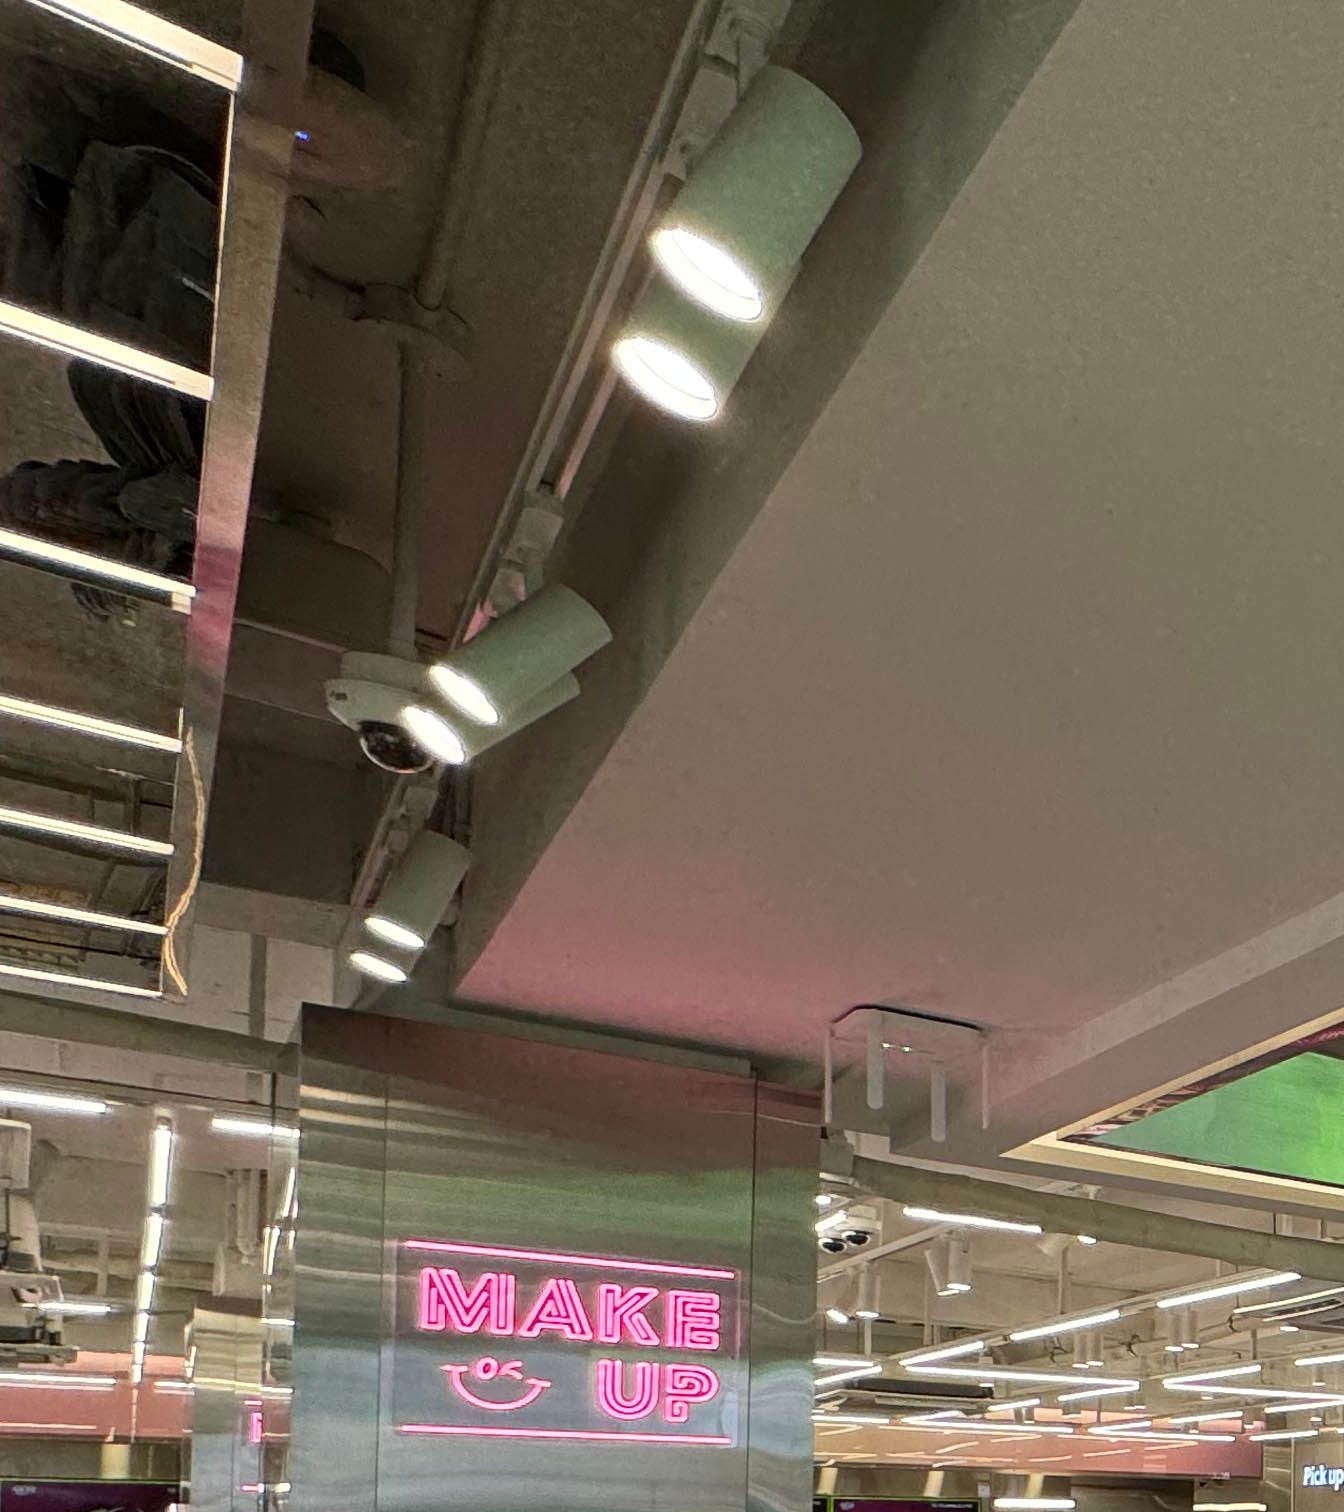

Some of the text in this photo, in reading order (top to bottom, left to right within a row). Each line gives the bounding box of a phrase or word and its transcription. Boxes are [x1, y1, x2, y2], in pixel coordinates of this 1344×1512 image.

[419, 1266, 721, 1351] MAKE
[597, 1358, 720, 1423] UP
[1302, 1465, 1344, 1491] Pick up
